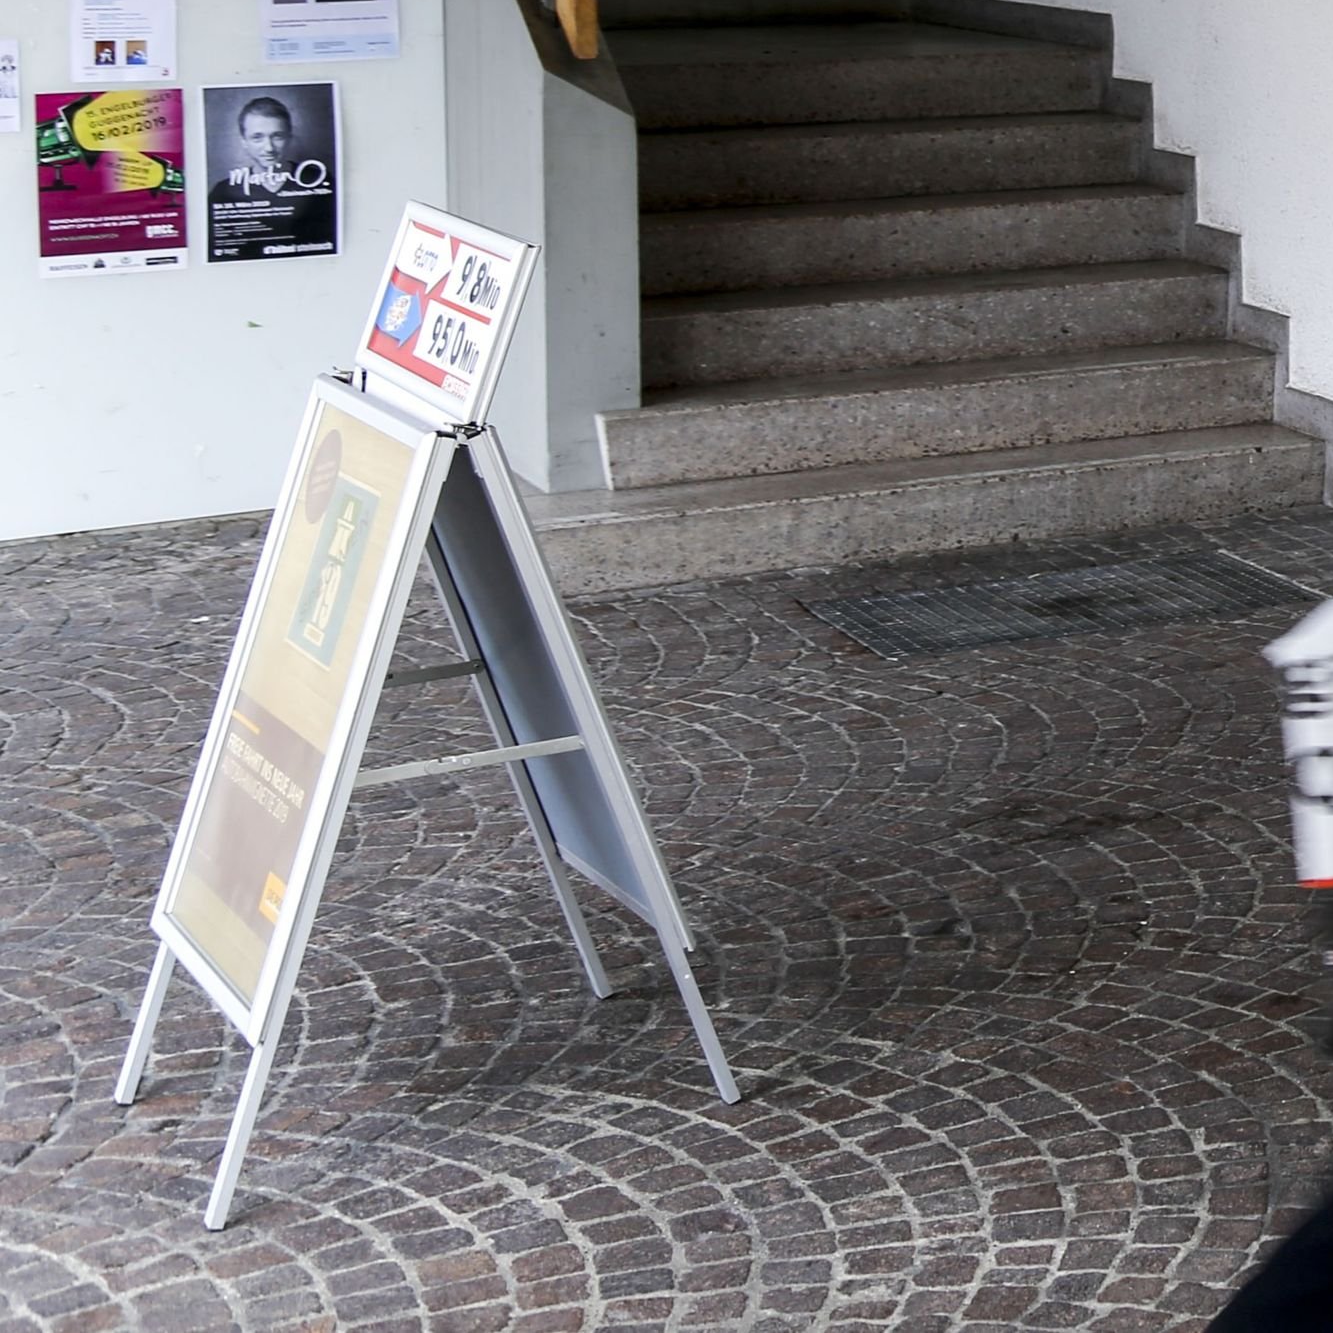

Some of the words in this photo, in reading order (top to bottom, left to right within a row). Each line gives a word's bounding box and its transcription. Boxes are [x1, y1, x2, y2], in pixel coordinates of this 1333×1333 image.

[91, 116, 167, 142] 16/02/2019
[228, 163, 293, 196] Martin
[478, 276, 501, 311] Mio
[458, 339, 480, 375] Mio
